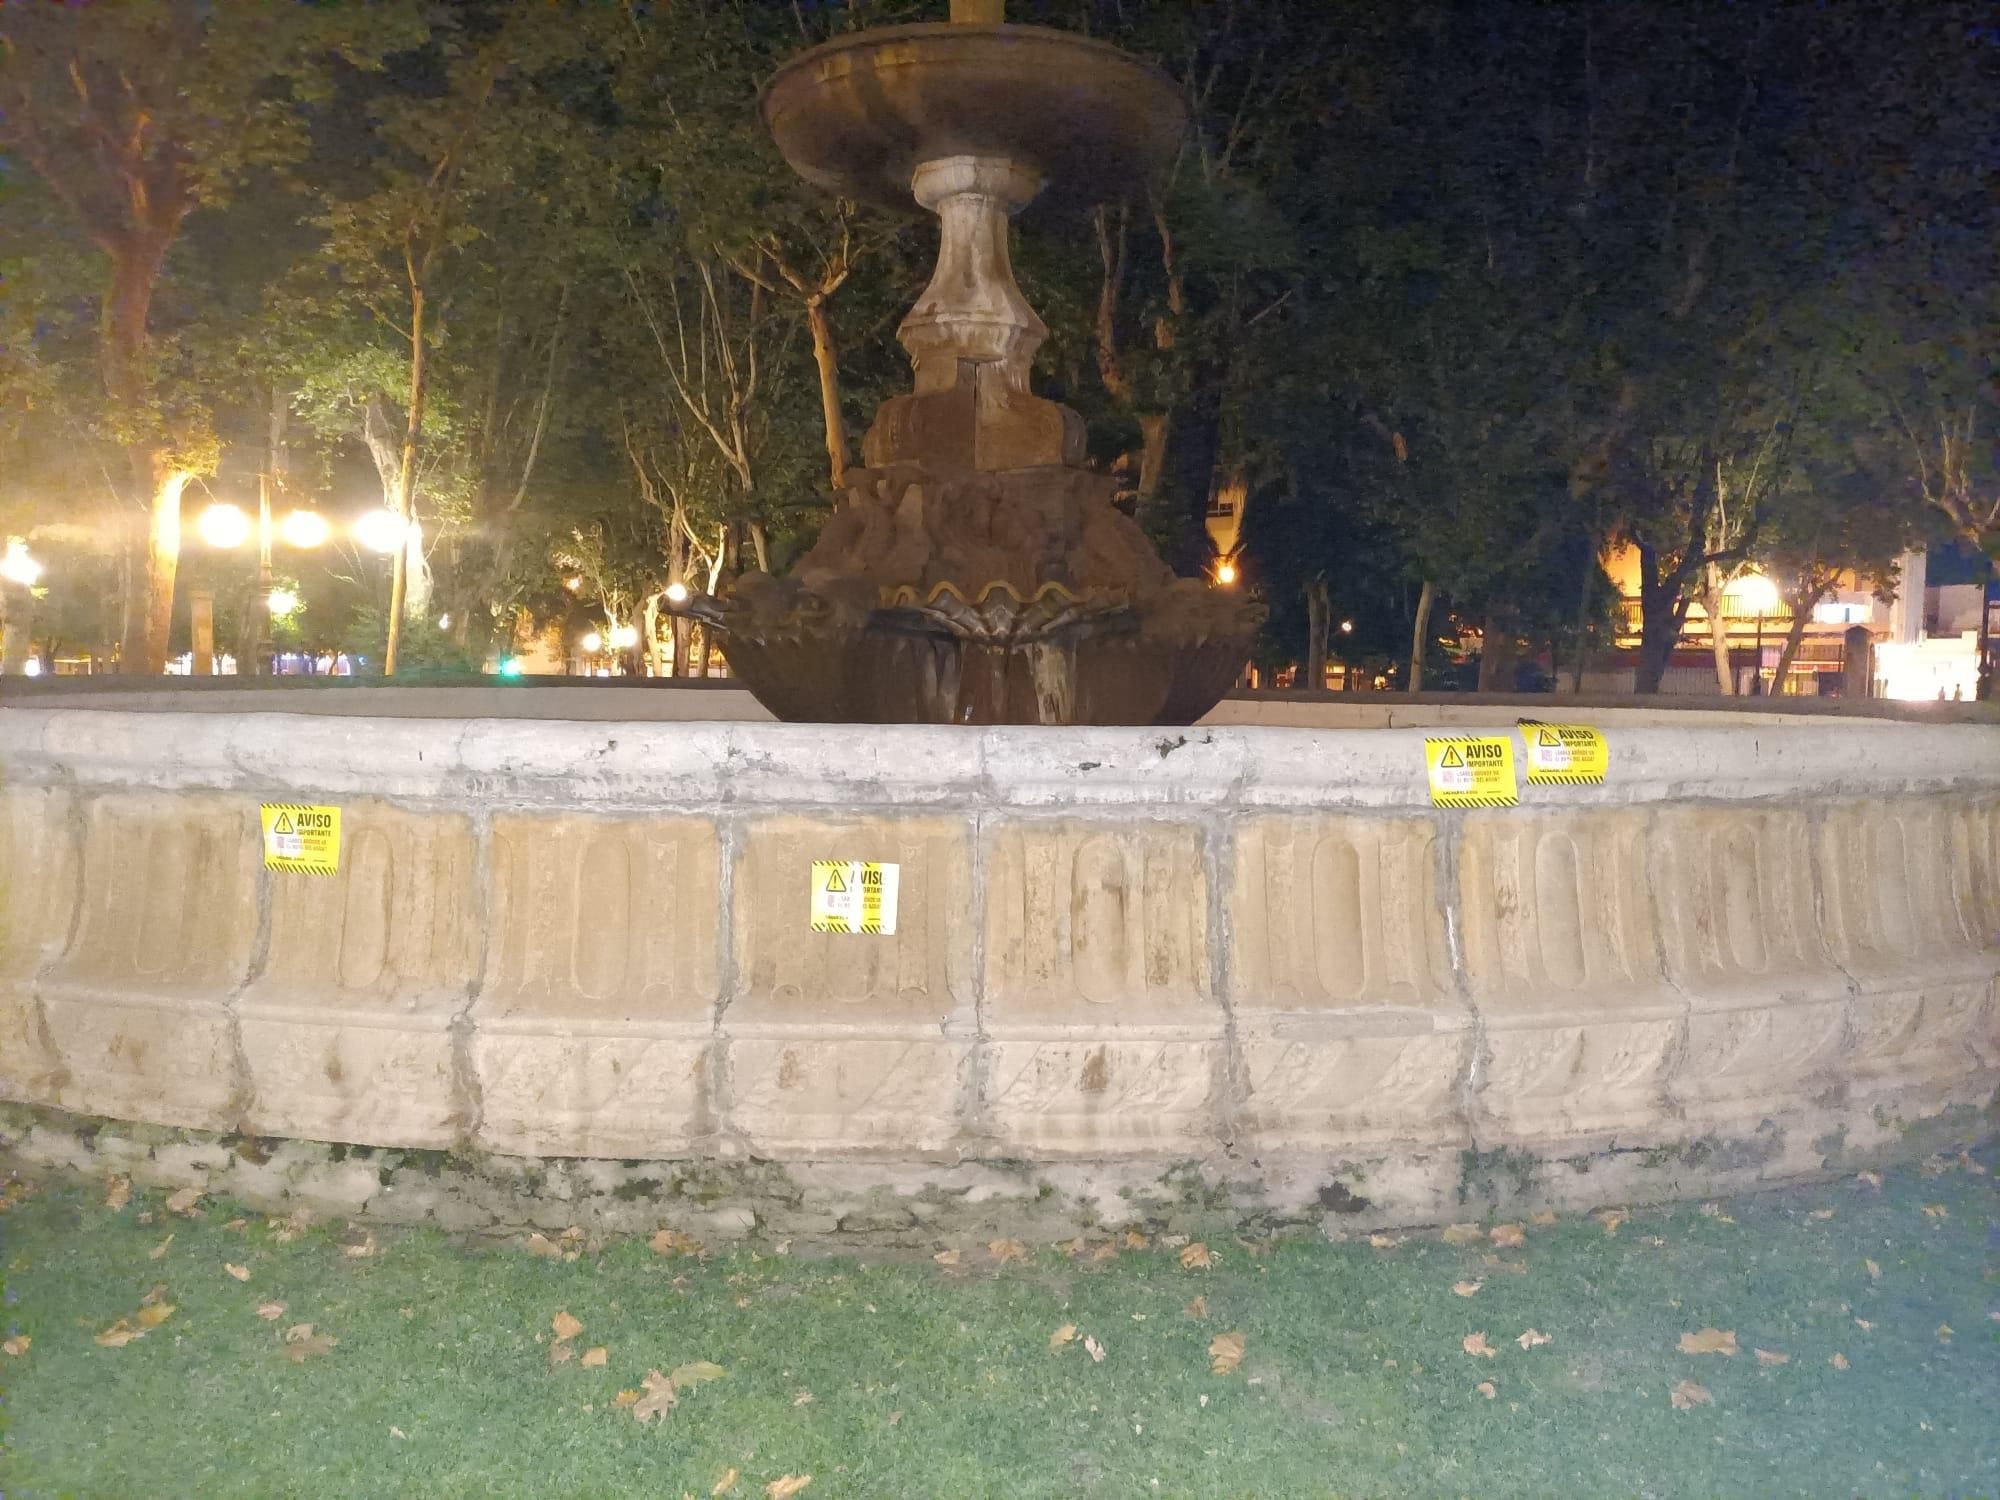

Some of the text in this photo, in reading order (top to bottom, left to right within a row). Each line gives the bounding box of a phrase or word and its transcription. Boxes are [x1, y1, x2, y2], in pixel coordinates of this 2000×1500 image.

[1559, 729, 1594, 739] AVISO
[1466, 744, 1502, 758] AVISO
[297, 813, 331, 828] AVISO
